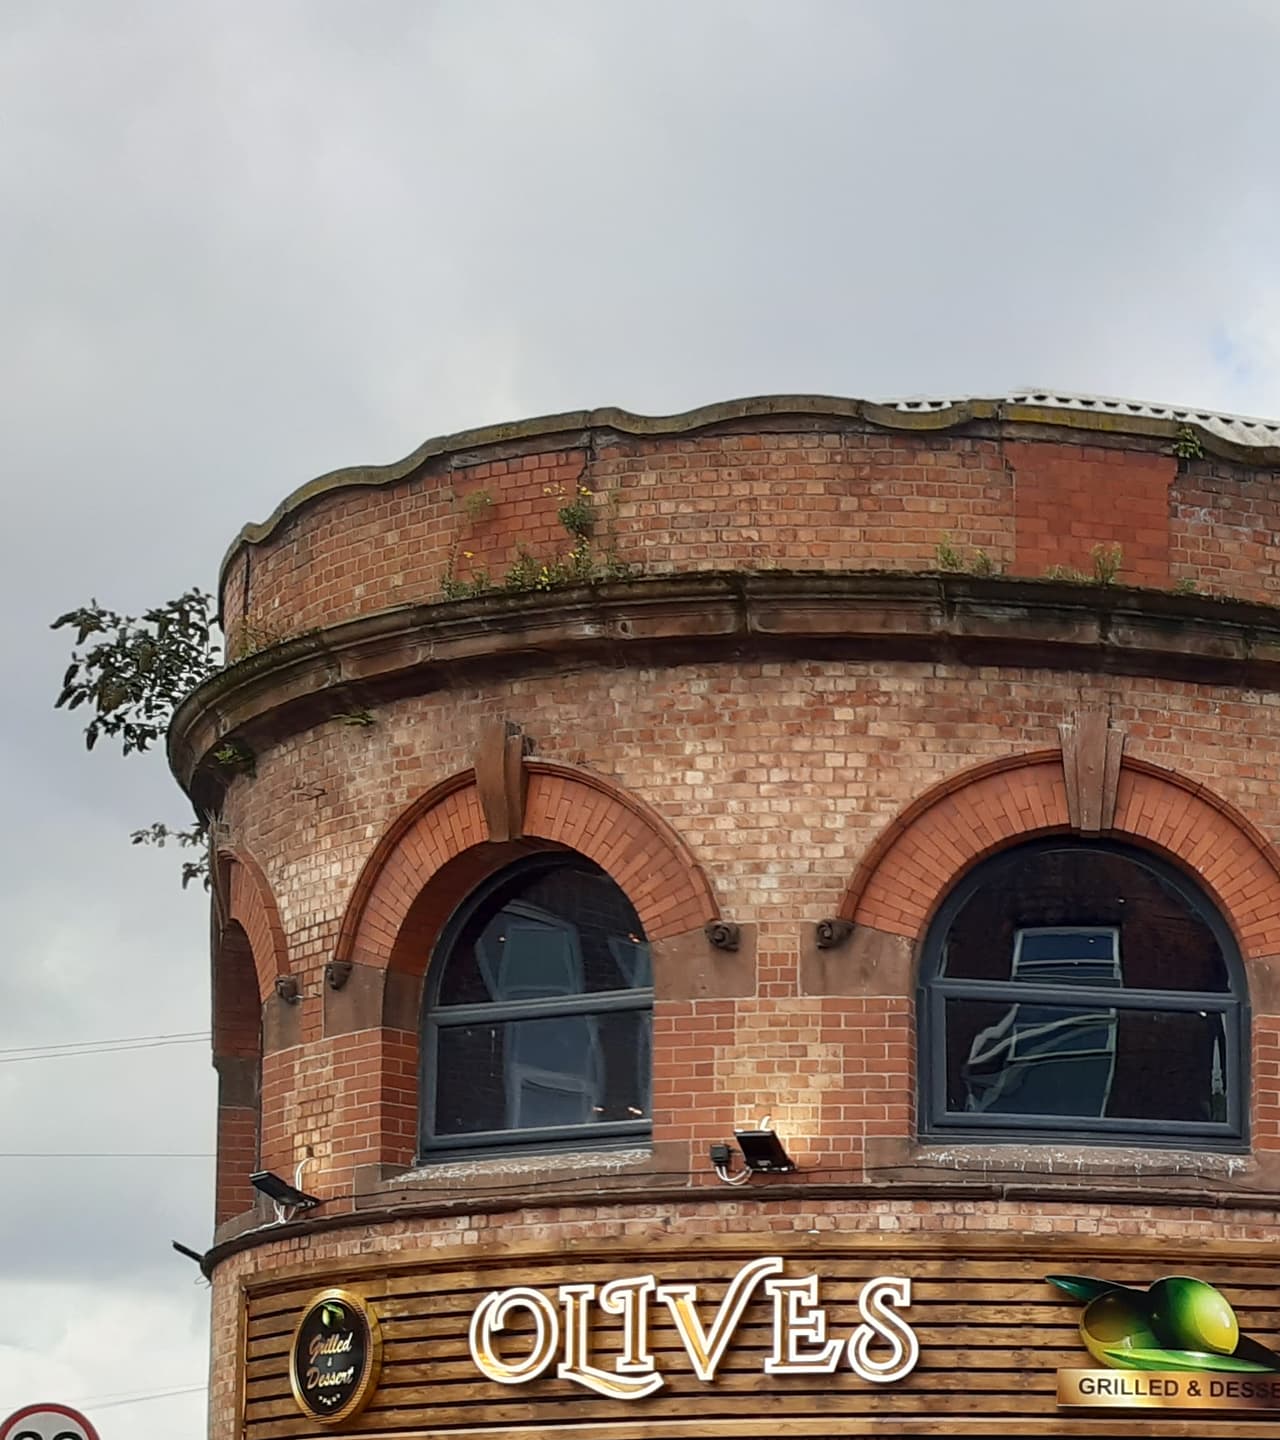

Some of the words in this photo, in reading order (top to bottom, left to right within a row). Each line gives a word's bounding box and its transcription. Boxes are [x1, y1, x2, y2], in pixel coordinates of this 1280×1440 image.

[468, 1256, 920, 1400] OLIVES
[308, 1331, 354, 1364] Grilled
[306, 1366, 355, 1390] Dessert
[1078, 1377, 1179, 1396] GRILLED
[1187, 1379, 1202, 1396] &
